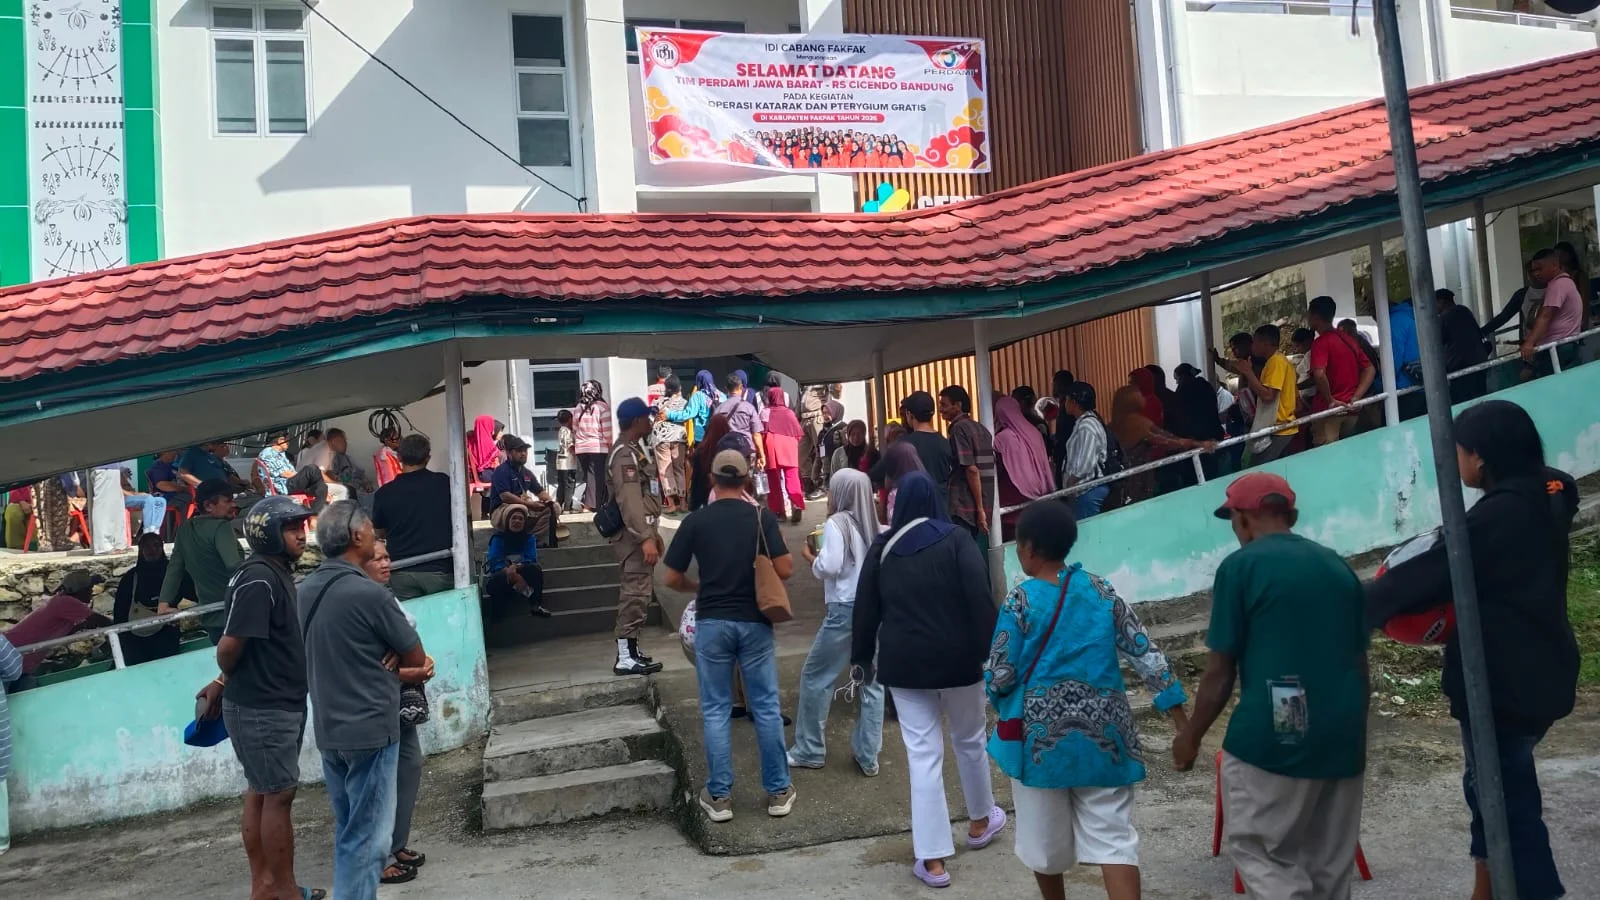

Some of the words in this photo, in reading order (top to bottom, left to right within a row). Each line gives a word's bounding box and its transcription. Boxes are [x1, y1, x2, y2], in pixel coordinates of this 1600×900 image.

[765, 43, 778, 52] IDI
[781, 43, 825, 53] CABANG
[828, 45, 866, 54] FAKFAK
[736, 63, 819, 78] SELAMAT
[822, 64, 896, 79] DATANG
[923, 68, 975, 76] PERDAMI
[675, 75, 695, 86] TIM
[698, 77, 750, 88] PERDAMI
[752, 79, 783, 89] JAWA
[786, 80, 823, 89] BARAT
[832, 80, 847, 89] RS
[849, 80, 898, 90] CICENDO
[900, 82, 954, 92] BANDUNG
[783, 92, 807, 101] PADA
[809, 93, 854, 101] KEGIATAN
[708, 100, 753, 110] OPERASI
[755, 101, 803, 110] KATARAK
[805, 102, 828, 111] DAN
[830, 102, 889, 112] PTERYGIUM
[891, 103, 927, 112] GRATIS
